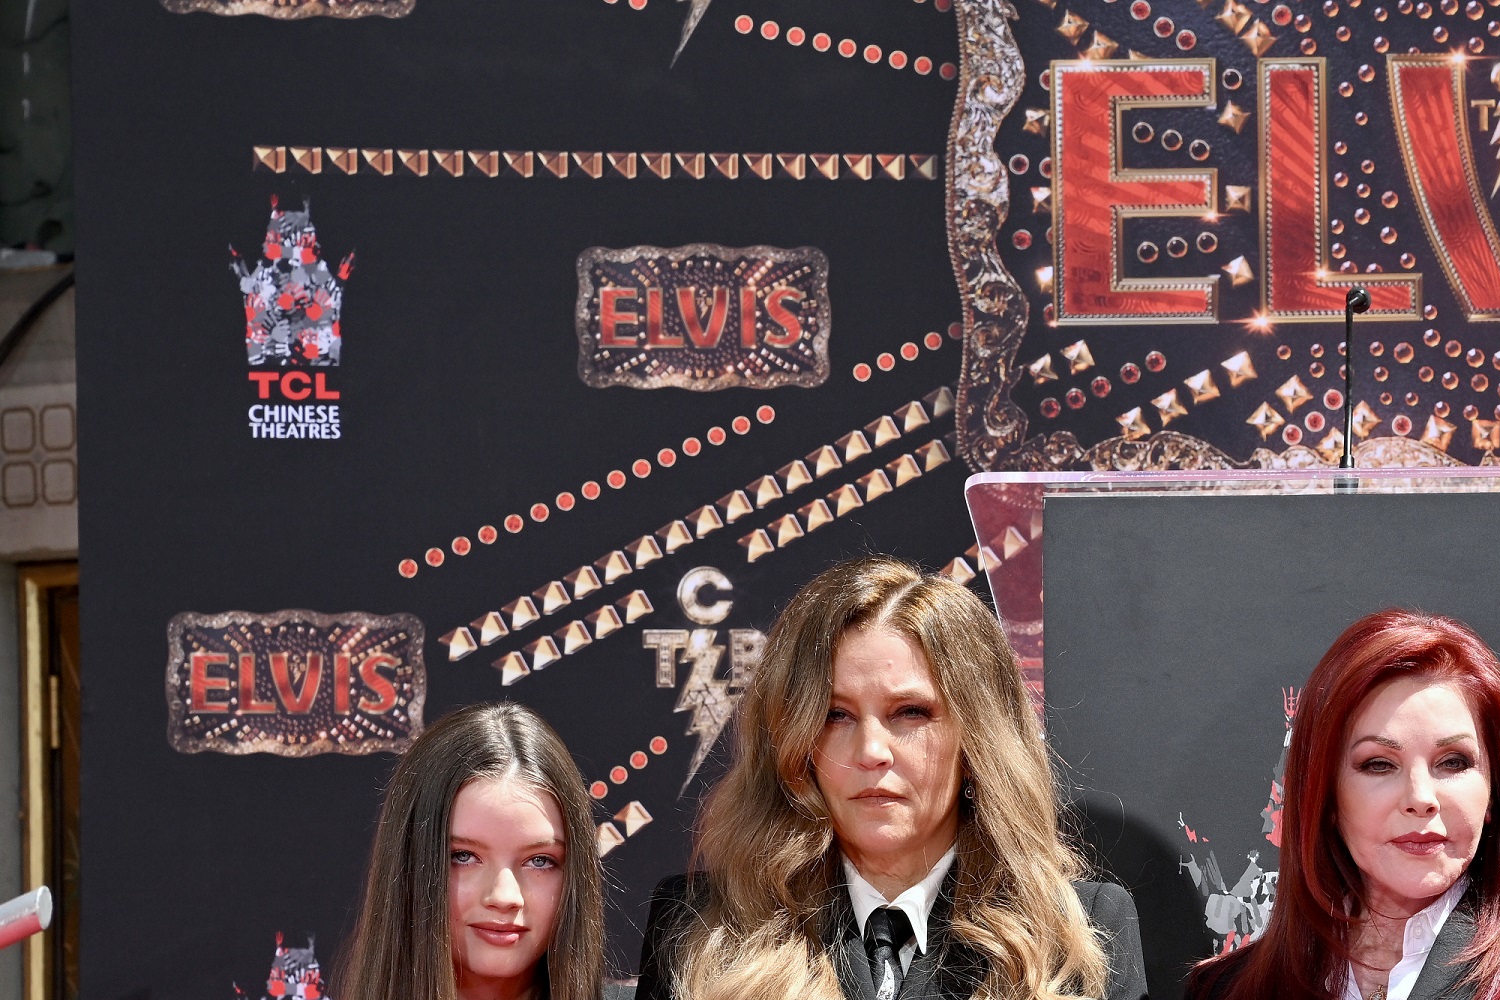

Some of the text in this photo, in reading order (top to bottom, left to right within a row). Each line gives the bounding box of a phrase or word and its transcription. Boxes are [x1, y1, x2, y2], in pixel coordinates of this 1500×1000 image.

[599, 286, 807, 349] ELVIS
[248, 370, 341, 401] TCL
[248, 404, 341, 423] CHINESE
[248, 422, 342, 440] THEATRES
[189, 652, 402, 715] ELVIS
